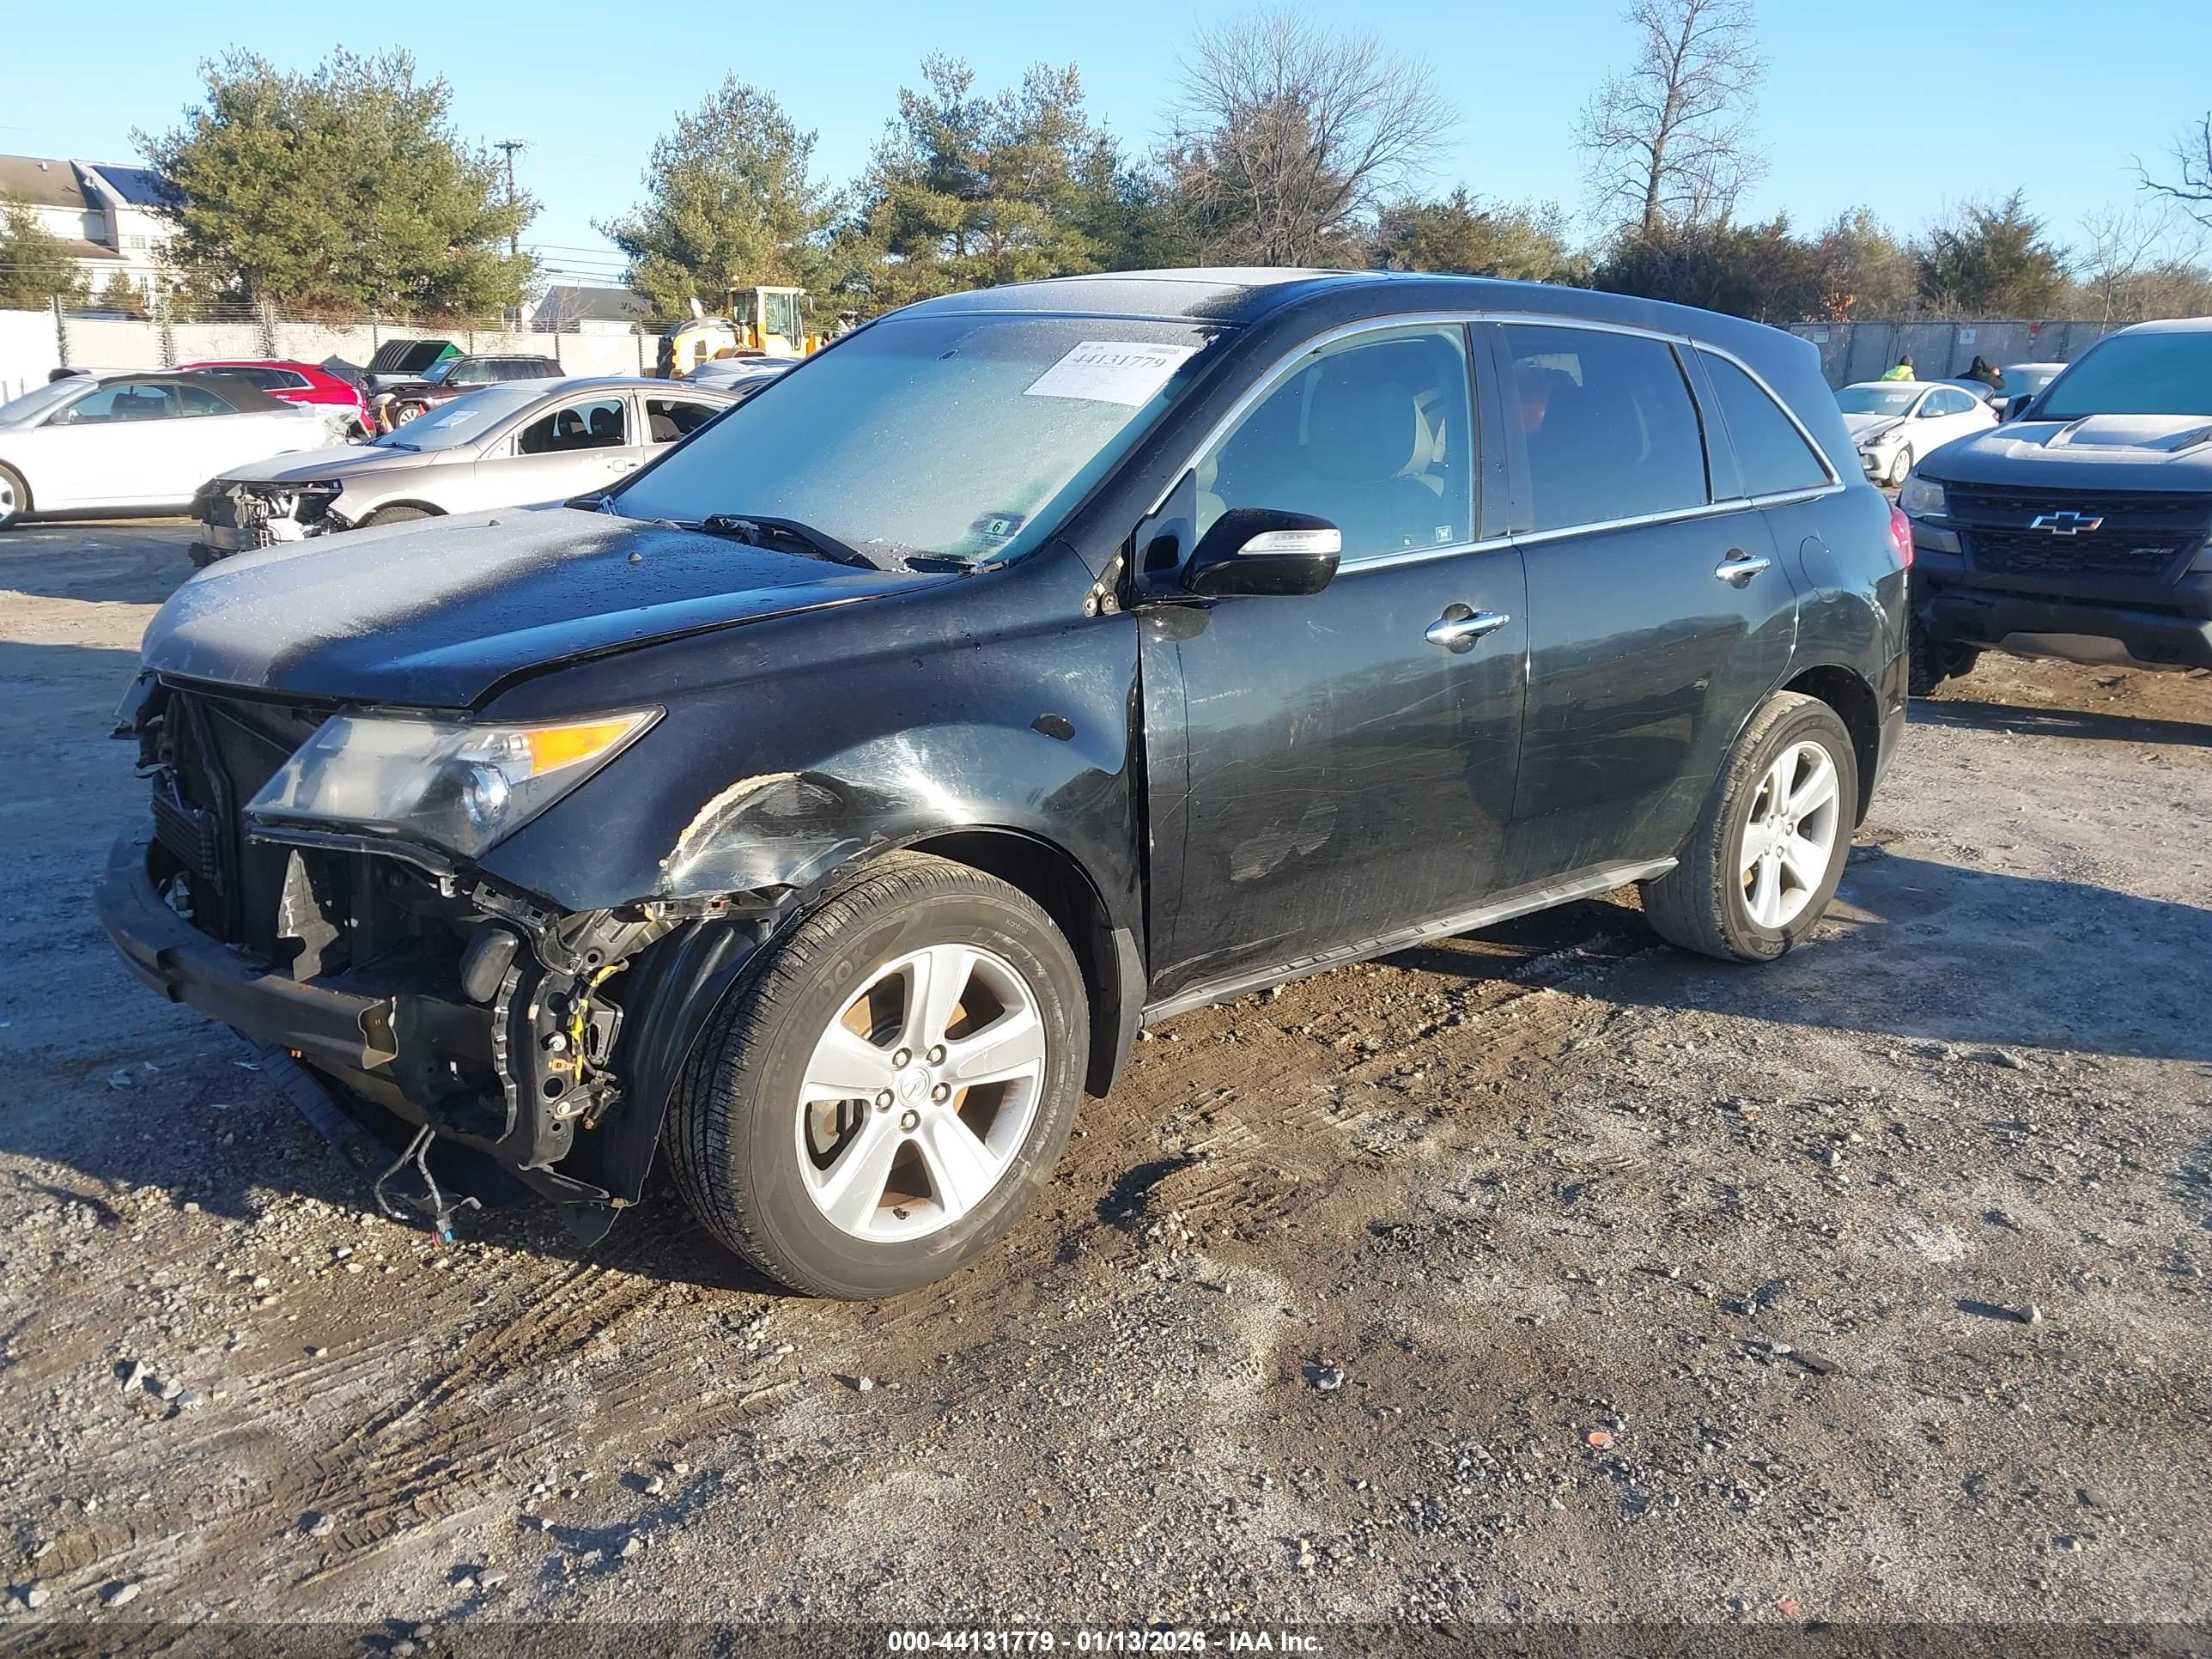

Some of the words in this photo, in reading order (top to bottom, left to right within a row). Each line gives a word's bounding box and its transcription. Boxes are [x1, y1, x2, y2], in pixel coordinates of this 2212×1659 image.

[1073, 353, 1168, 368] 44131779
[992, 520, 1003, 532] 6
[1006, 917, 1029, 935] Kontrol
